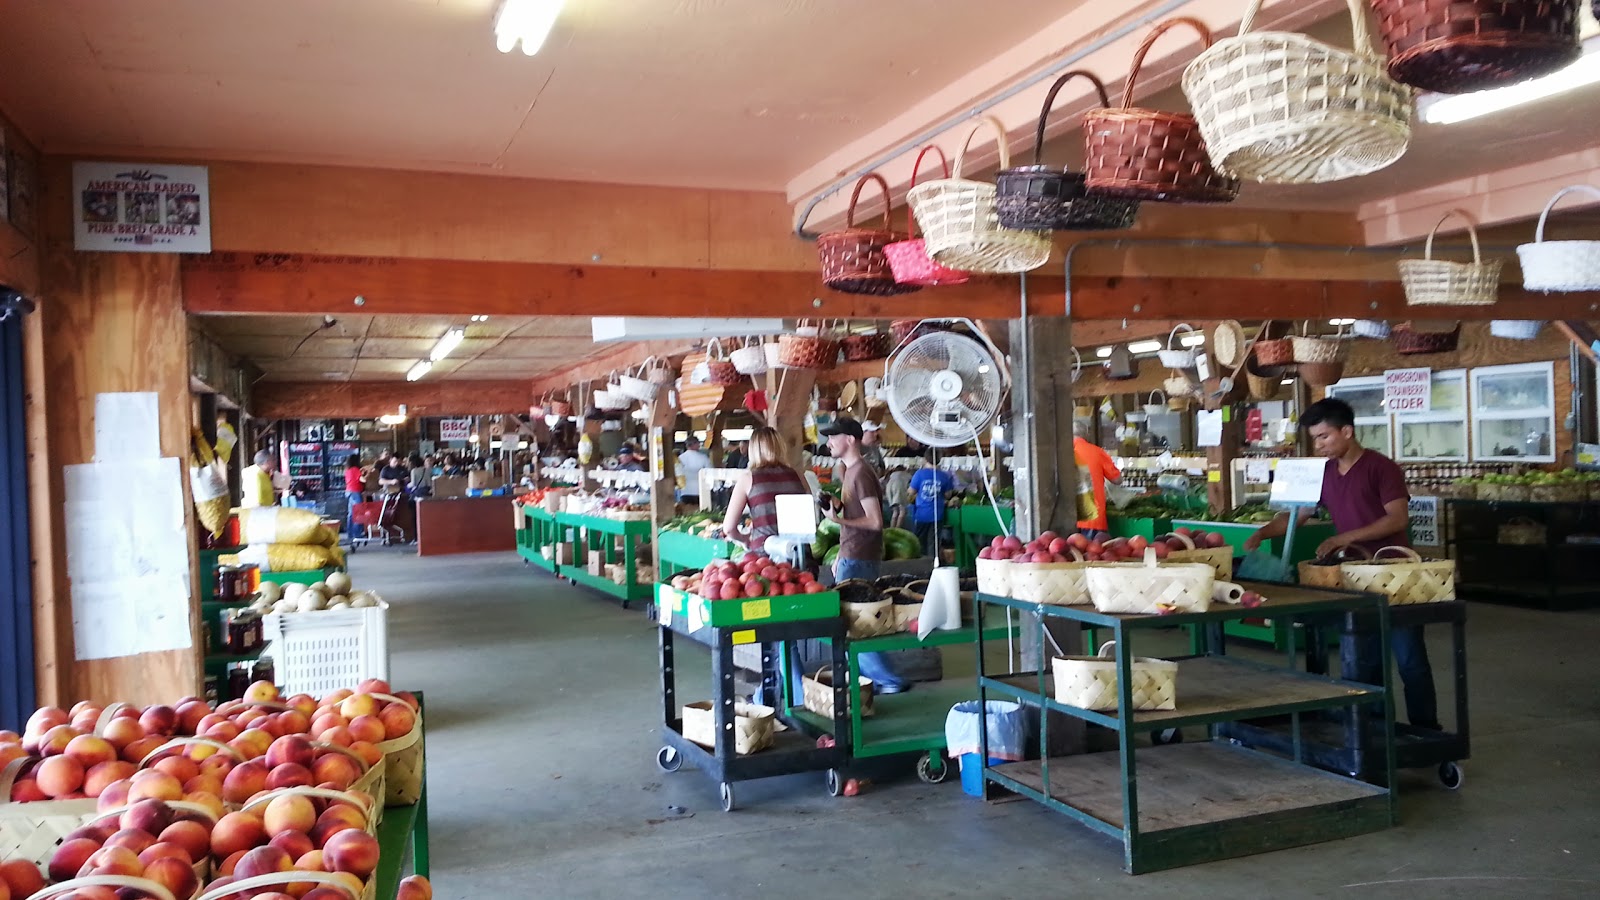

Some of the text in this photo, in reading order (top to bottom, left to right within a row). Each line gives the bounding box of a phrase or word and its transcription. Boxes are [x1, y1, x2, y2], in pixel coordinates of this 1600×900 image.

[87, 181, 196, 194] AMERICAN RAISED
[87, 223, 197, 236] PURE BRED GRADE A
[1386, 371, 1428, 383] HOMEGROWN
[1386, 384, 1428, 396] STRAWBERRY
[1389, 397, 1424, 410] CIDER
